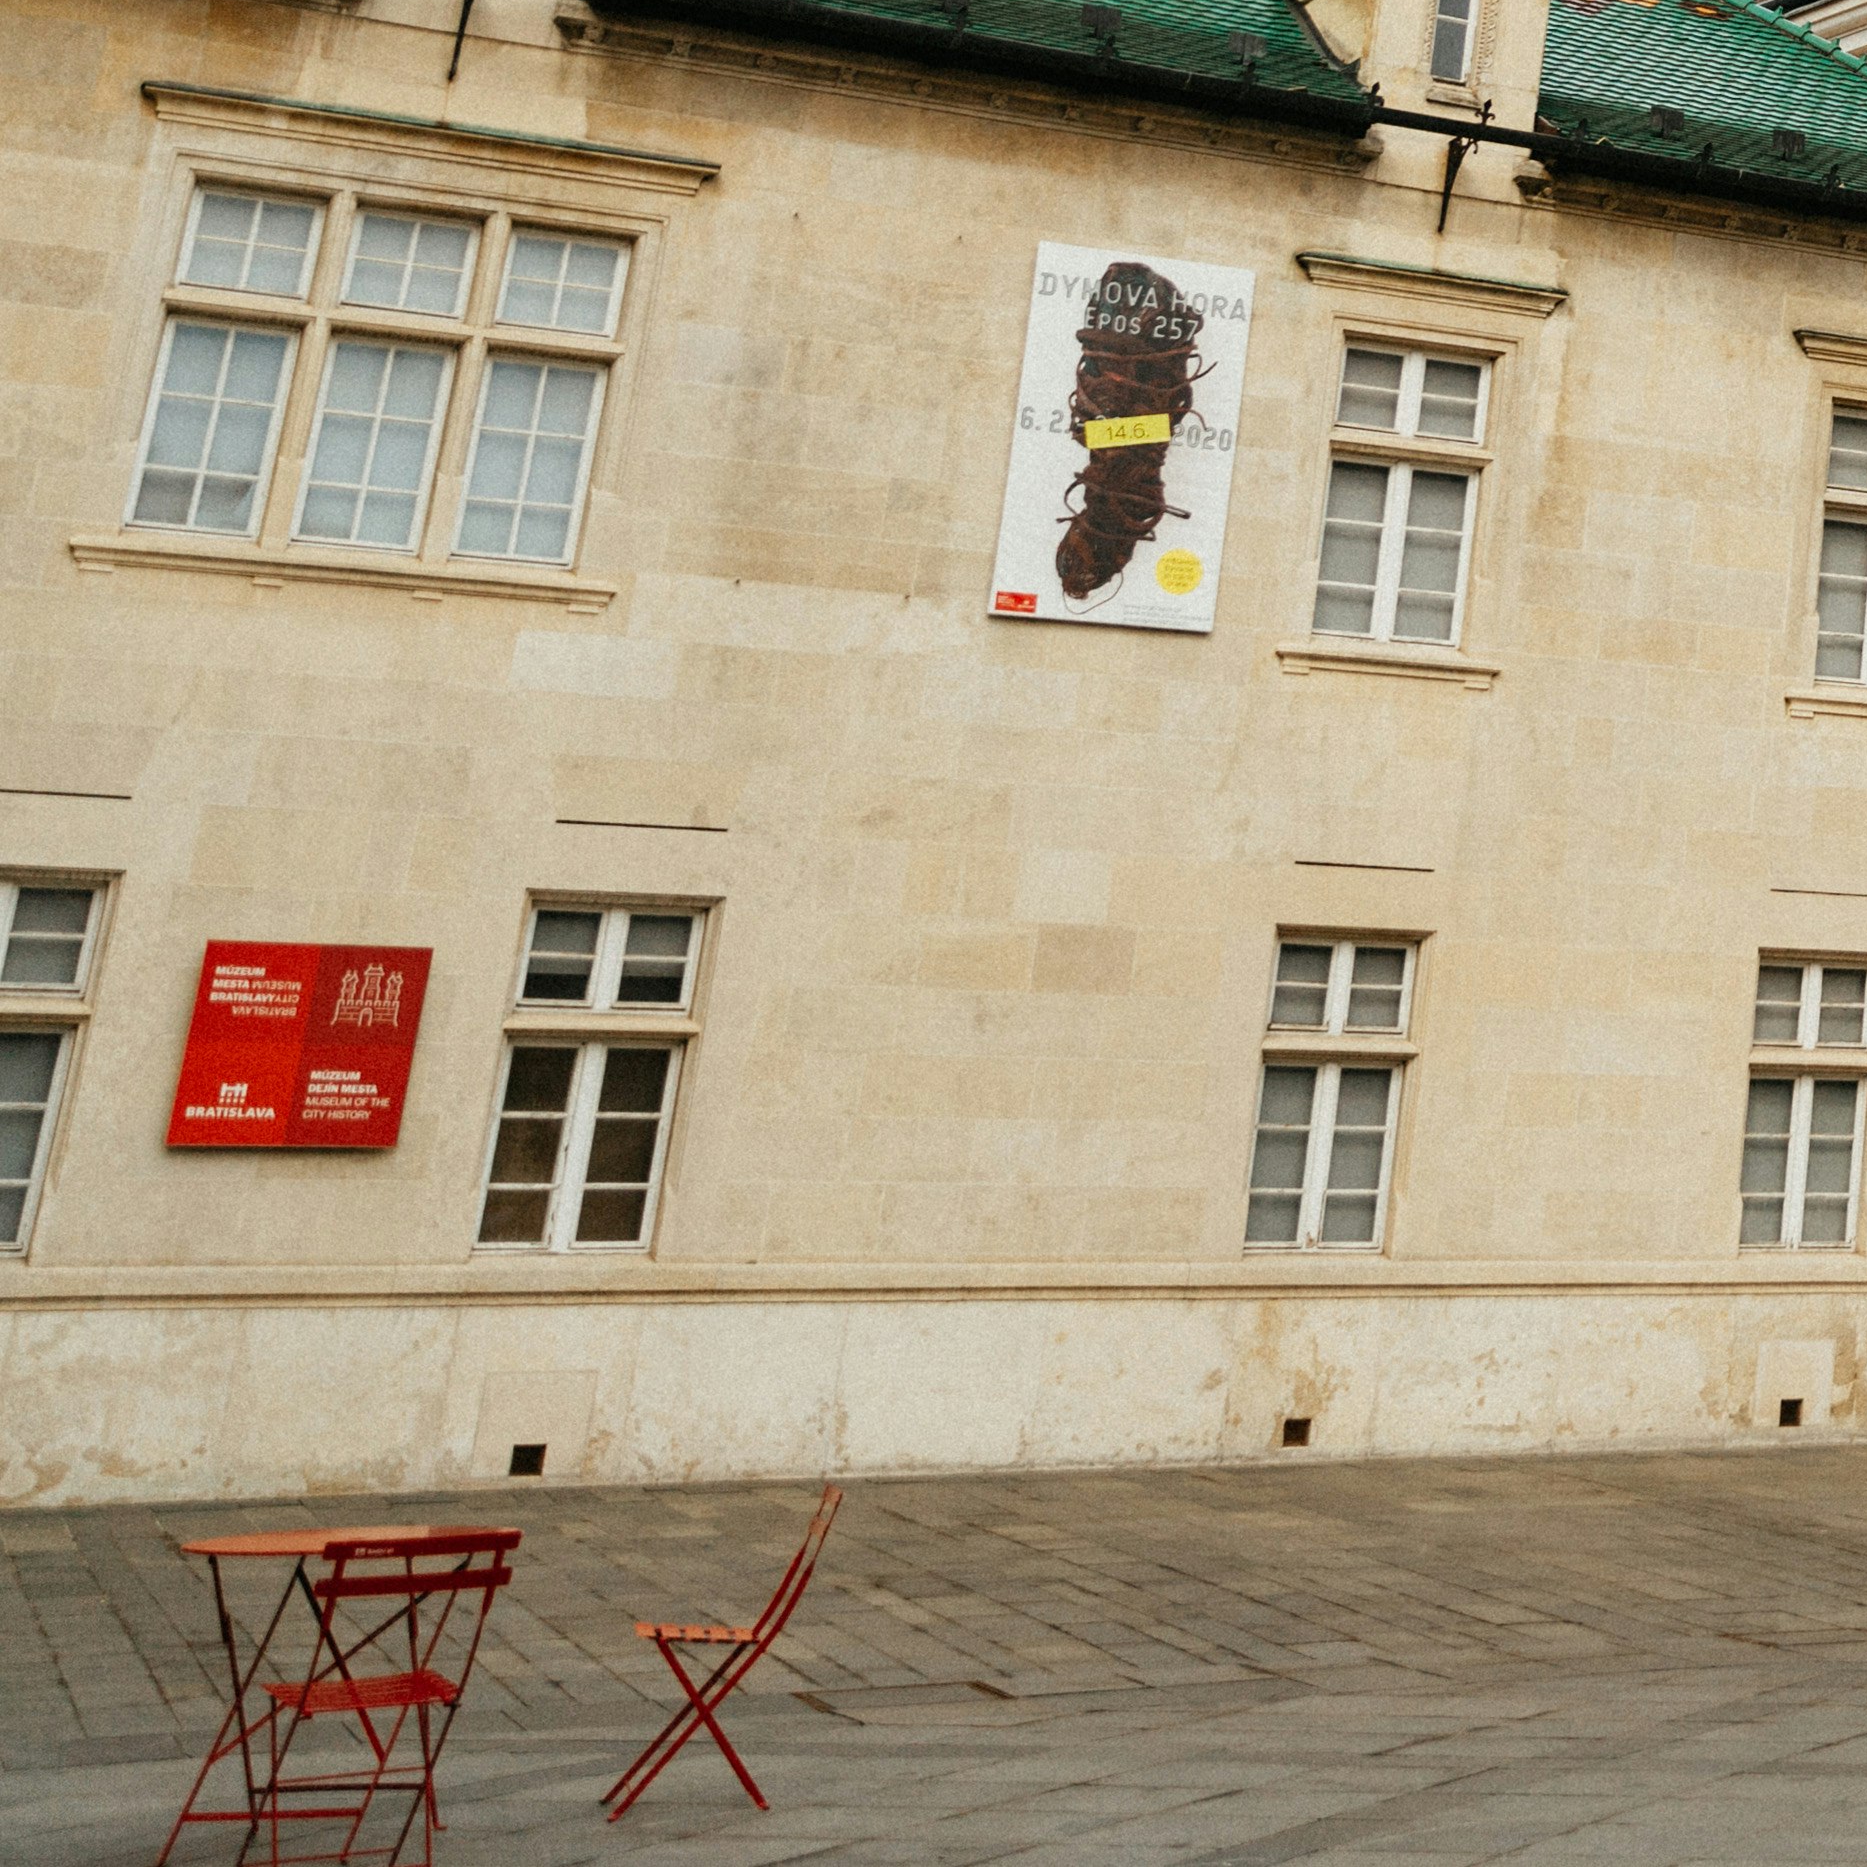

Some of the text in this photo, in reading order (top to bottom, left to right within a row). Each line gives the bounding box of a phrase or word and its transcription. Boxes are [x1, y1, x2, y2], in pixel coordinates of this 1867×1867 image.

[1038, 271, 1247, 322] DYMOVÁ HORA
[1084, 305, 1199, 342] EPOS 257
[1019, 405, 1040, 431] 6.
[1171, 422, 1234, 452] 2020
[215, 963, 266, 977] MÚZEUM
[212, 978, 250, 989] MESTA
[252, 980, 302, 992] MUSEUM
[209, 991, 275, 1003] BRATISLAVY
[231, 1005, 298, 1017] BRATISLAVA
[310, 1069, 362, 1082] MÚZEUM
[307, 1083, 379, 1095] DEJÍN MESTA
[304, 1096, 391, 1108] MUSEUM OF THE
[184, 1105, 276, 1120] BRATISLAVA
[302, 1108, 373, 1121] CITY HISTORY
